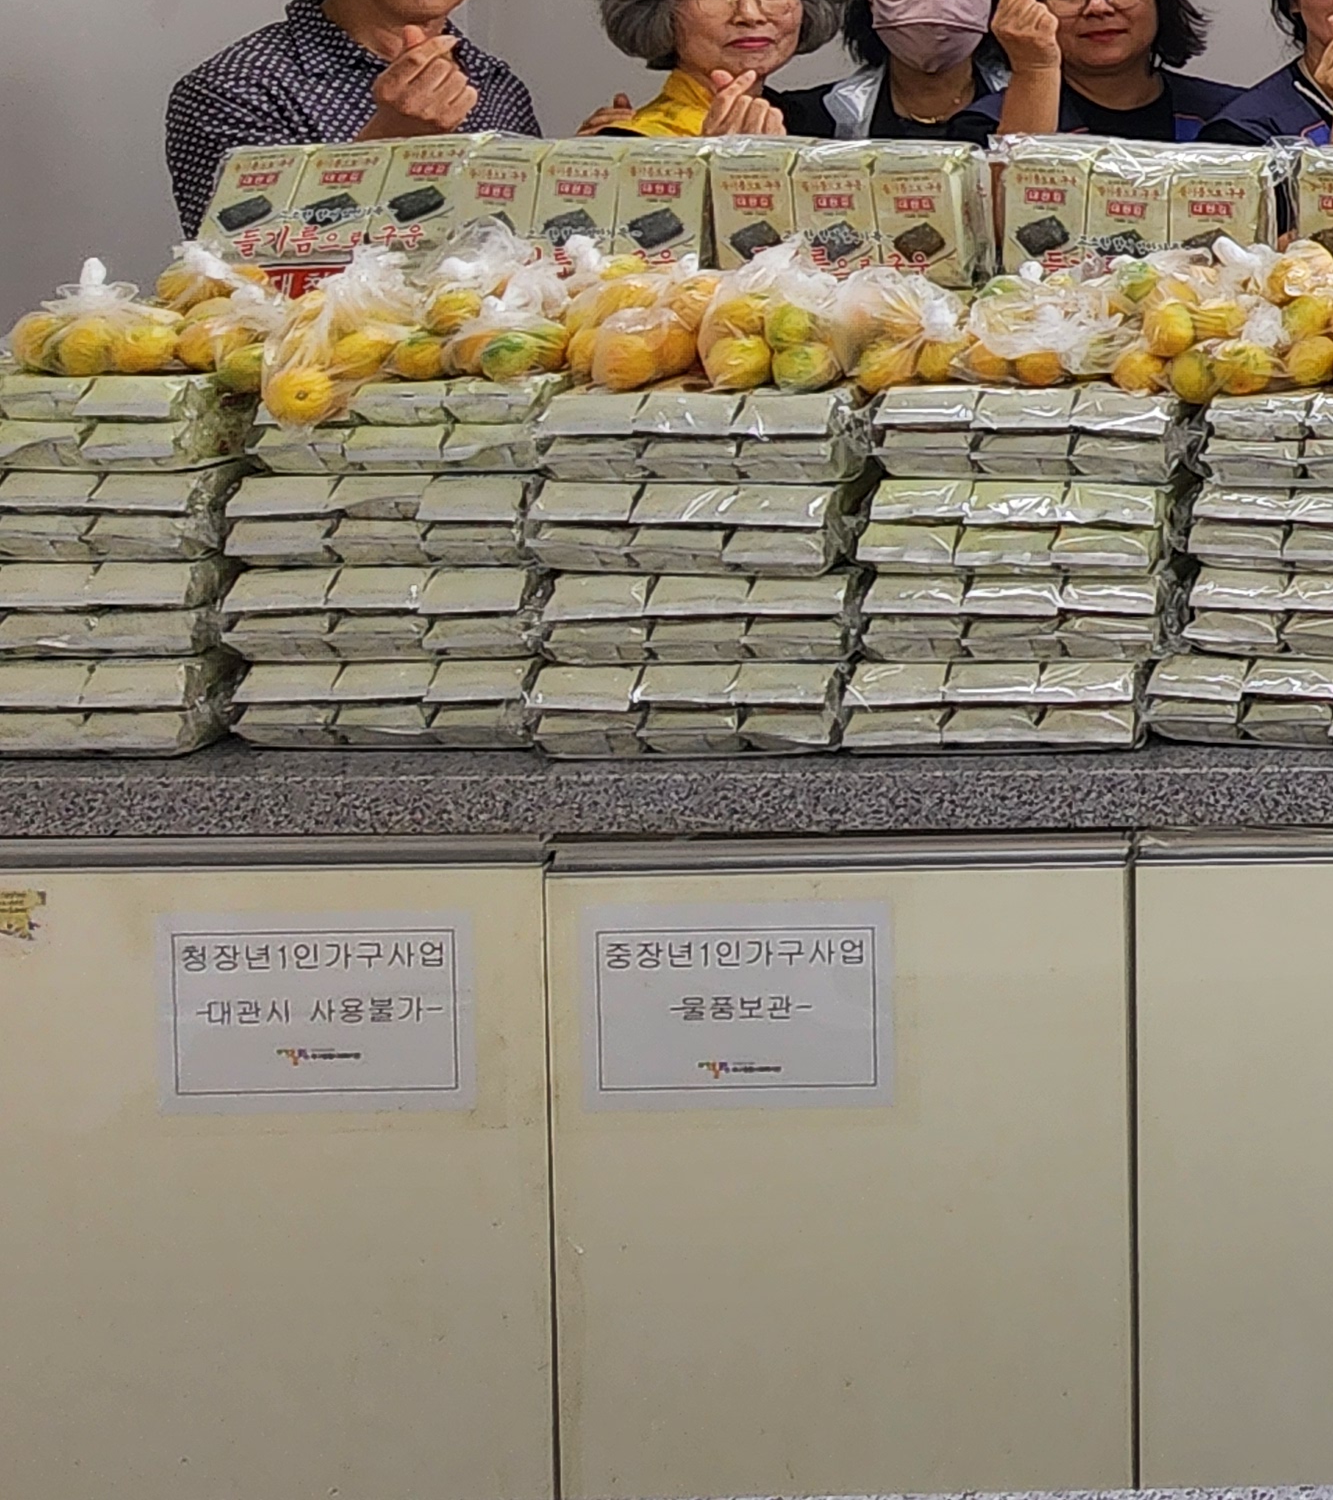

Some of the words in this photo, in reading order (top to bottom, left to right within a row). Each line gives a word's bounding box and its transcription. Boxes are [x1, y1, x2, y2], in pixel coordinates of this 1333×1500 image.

[233, 226, 362, 257] 들기름으로
[373, 224, 424, 249] 구운
[182, 941, 444, 972] 청장년1인가구사업
[606, 939, 864, 970] 중장년1인가구사업
[196, 999, 290, 1025] -대관시
[310, 996, 443, 1024] 사용불가-
[670, 995, 812, 1022] -물품보관-
